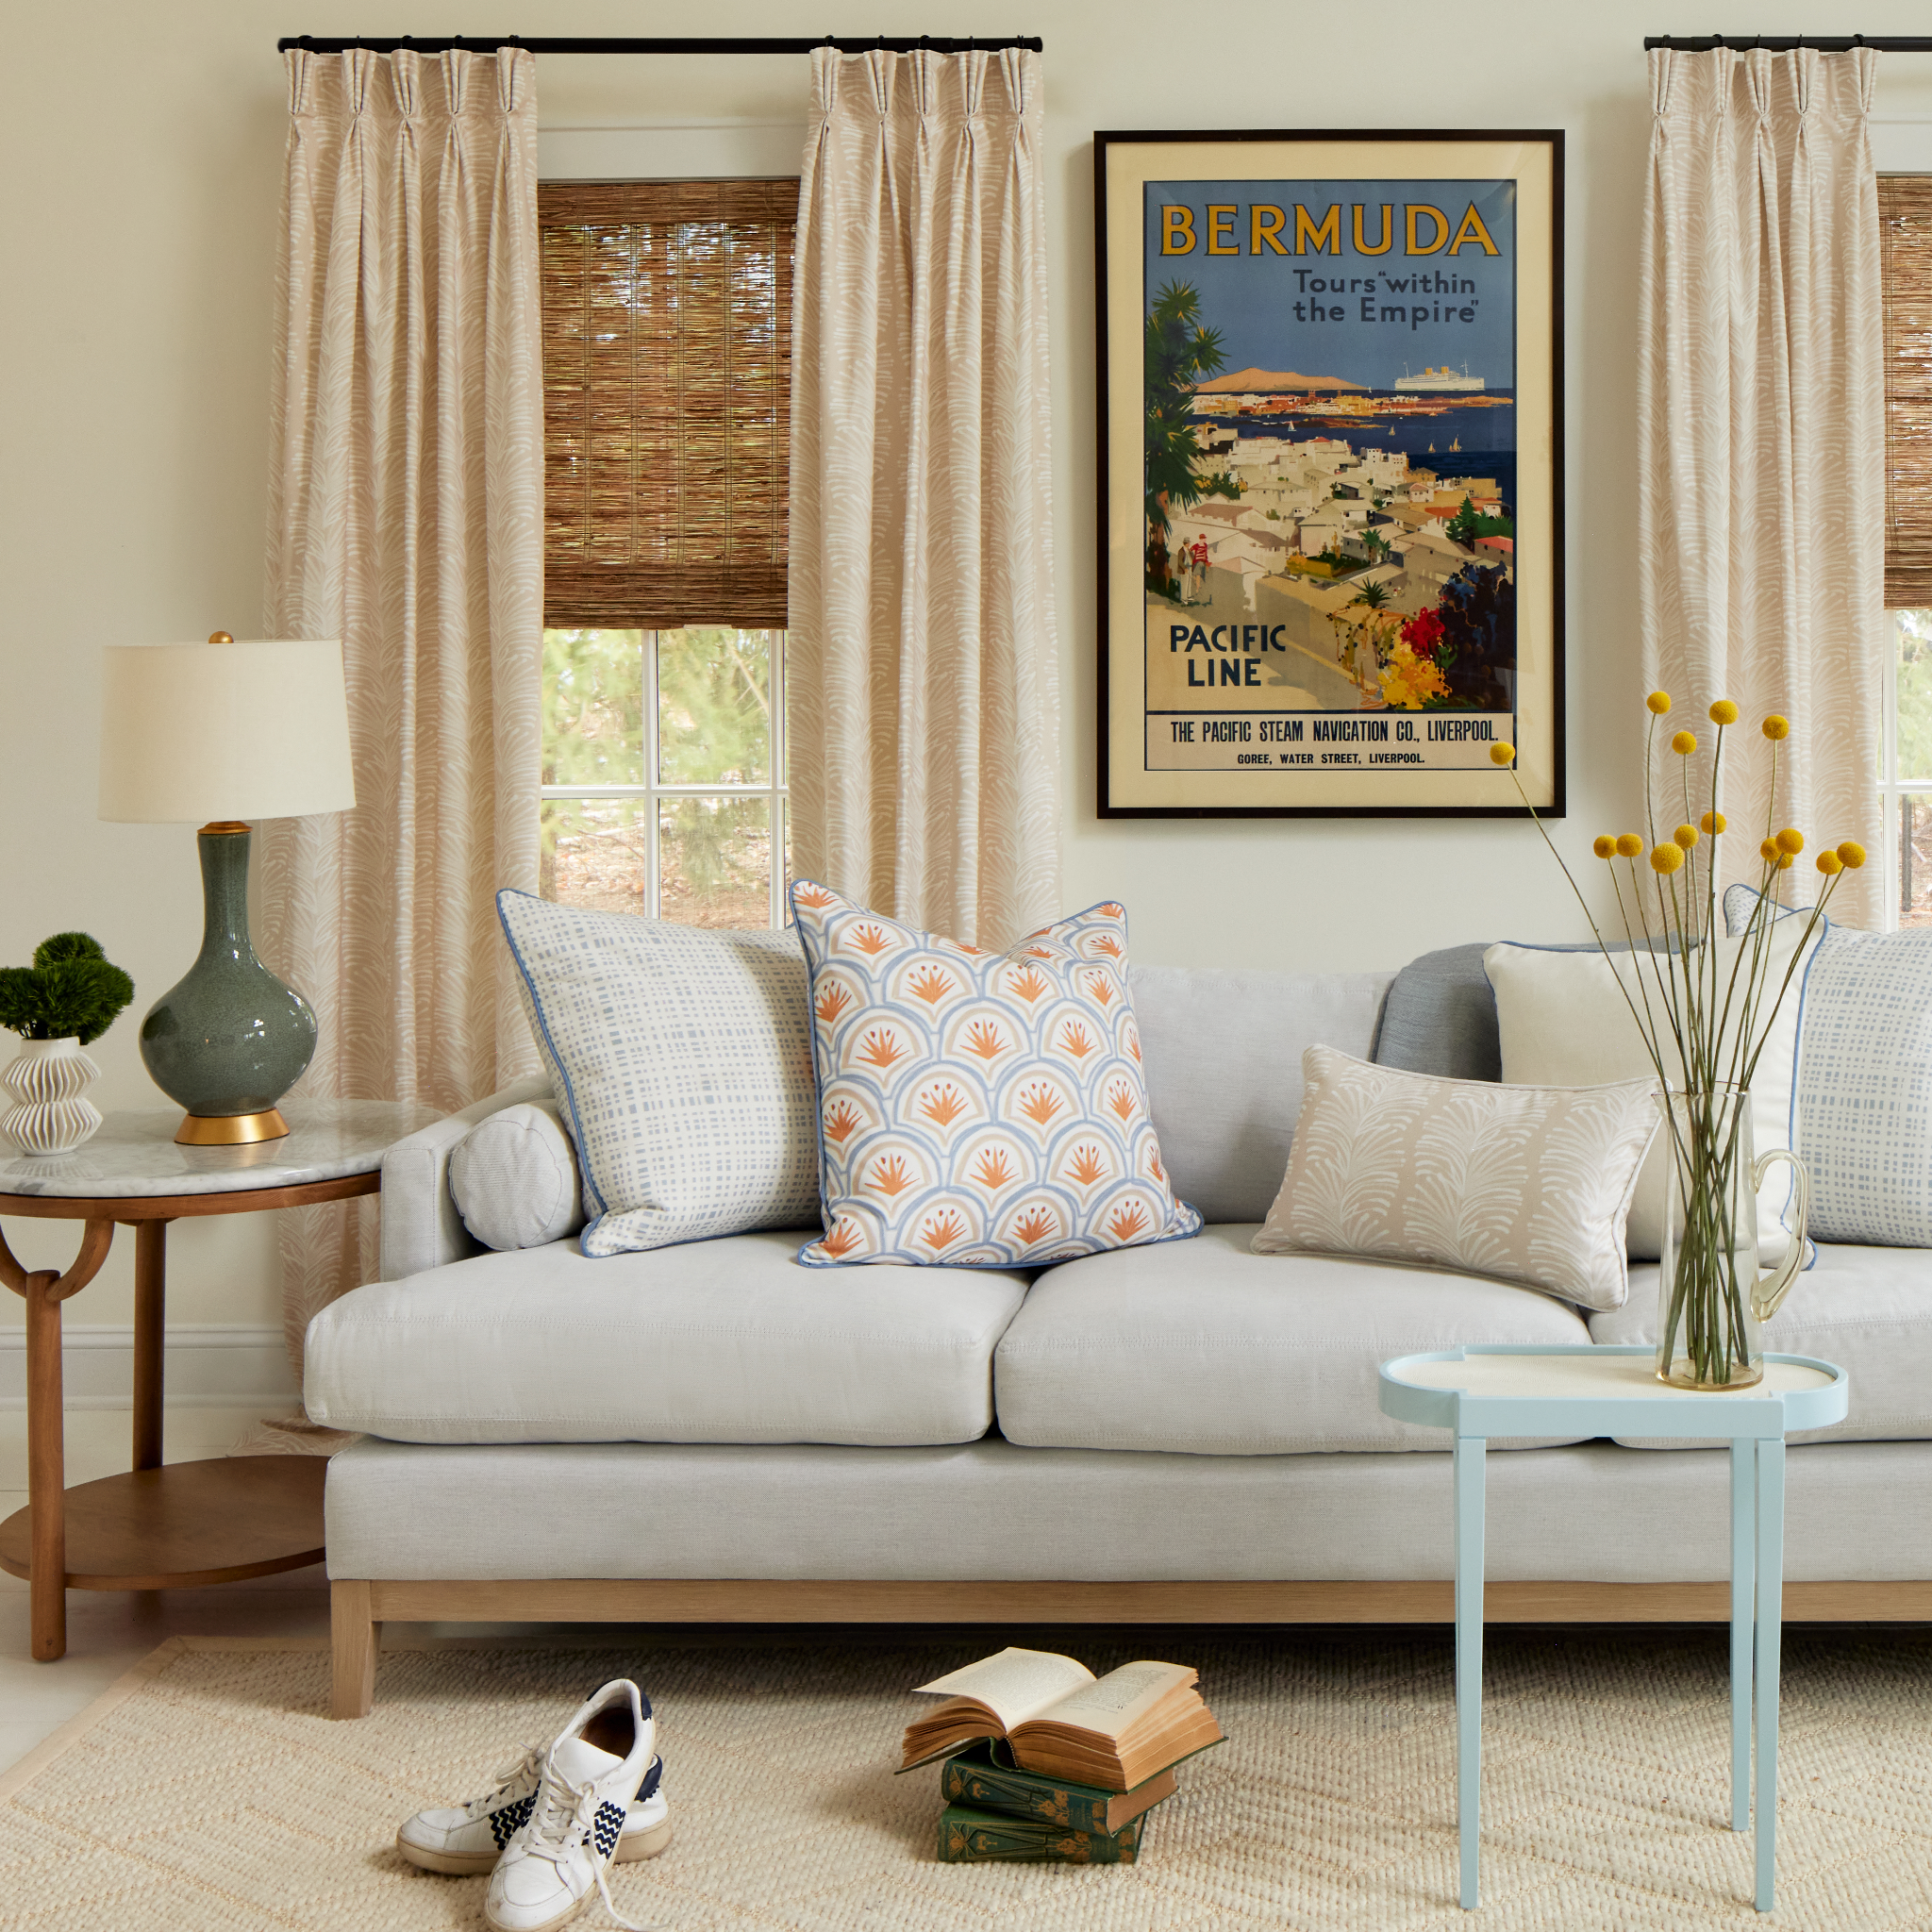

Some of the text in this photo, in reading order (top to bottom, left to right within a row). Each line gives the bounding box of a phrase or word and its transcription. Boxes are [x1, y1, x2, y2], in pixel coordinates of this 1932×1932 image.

[1159, 199, 1503, 257] BERMUDA
[1292, 269, 1376, 293] Tours
[1292, 297, 1345, 323] the
[1170, 624, 1286, 652] PACIFIC
[1187, 658, 1262, 687] LINE
[1170, 720, 1500, 743] THE PACIFIC STEAM NAVIGATION CO., LIVERPOOL.
[1237, 753, 1425, 766] GOREE, WATER STREET, LIVERPOOL.
